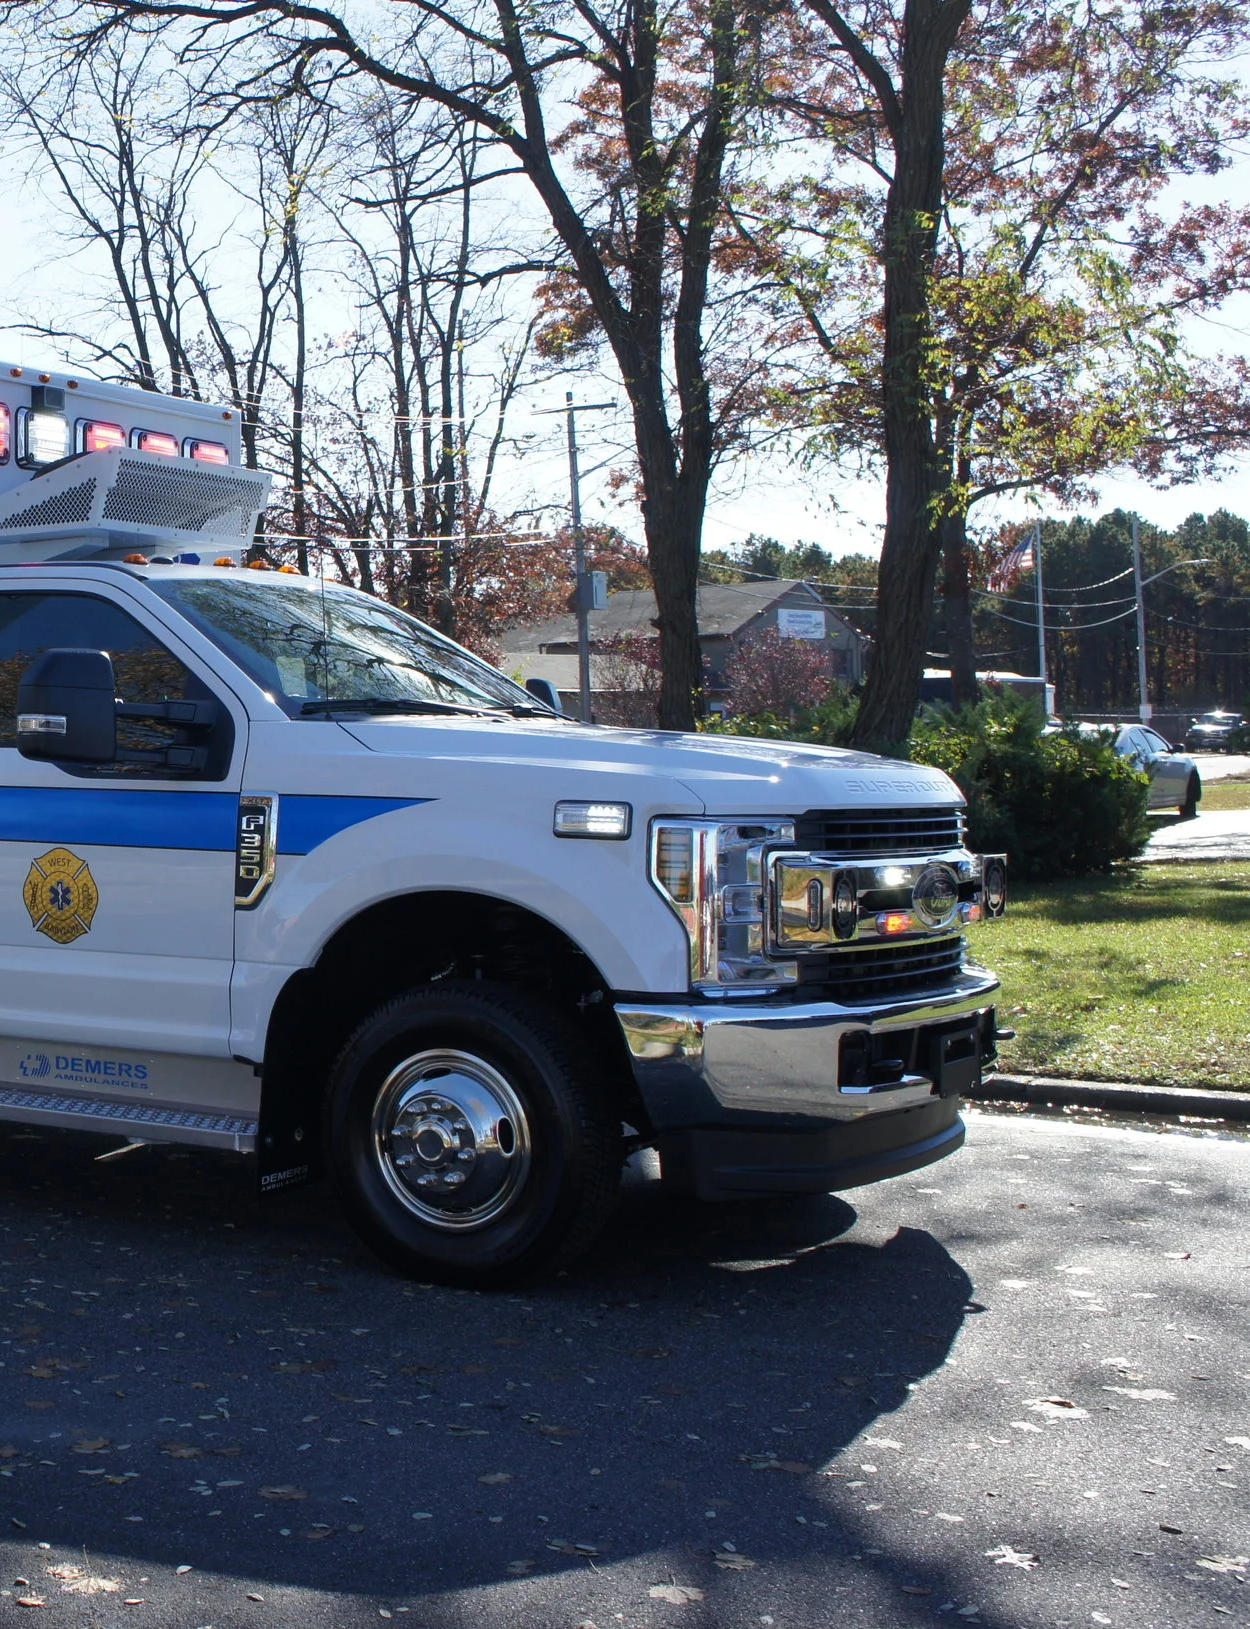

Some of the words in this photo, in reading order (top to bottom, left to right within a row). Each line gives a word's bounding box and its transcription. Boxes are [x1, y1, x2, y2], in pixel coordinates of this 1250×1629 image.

[240, 815, 264, 879] F350
[48, 858, 72, 868] WEST
[55, 1055, 148, 1080] DEMERS
[54, 1073, 149, 1090] AMBULANCES
[261, 1164, 309, 1185] DEMERS
